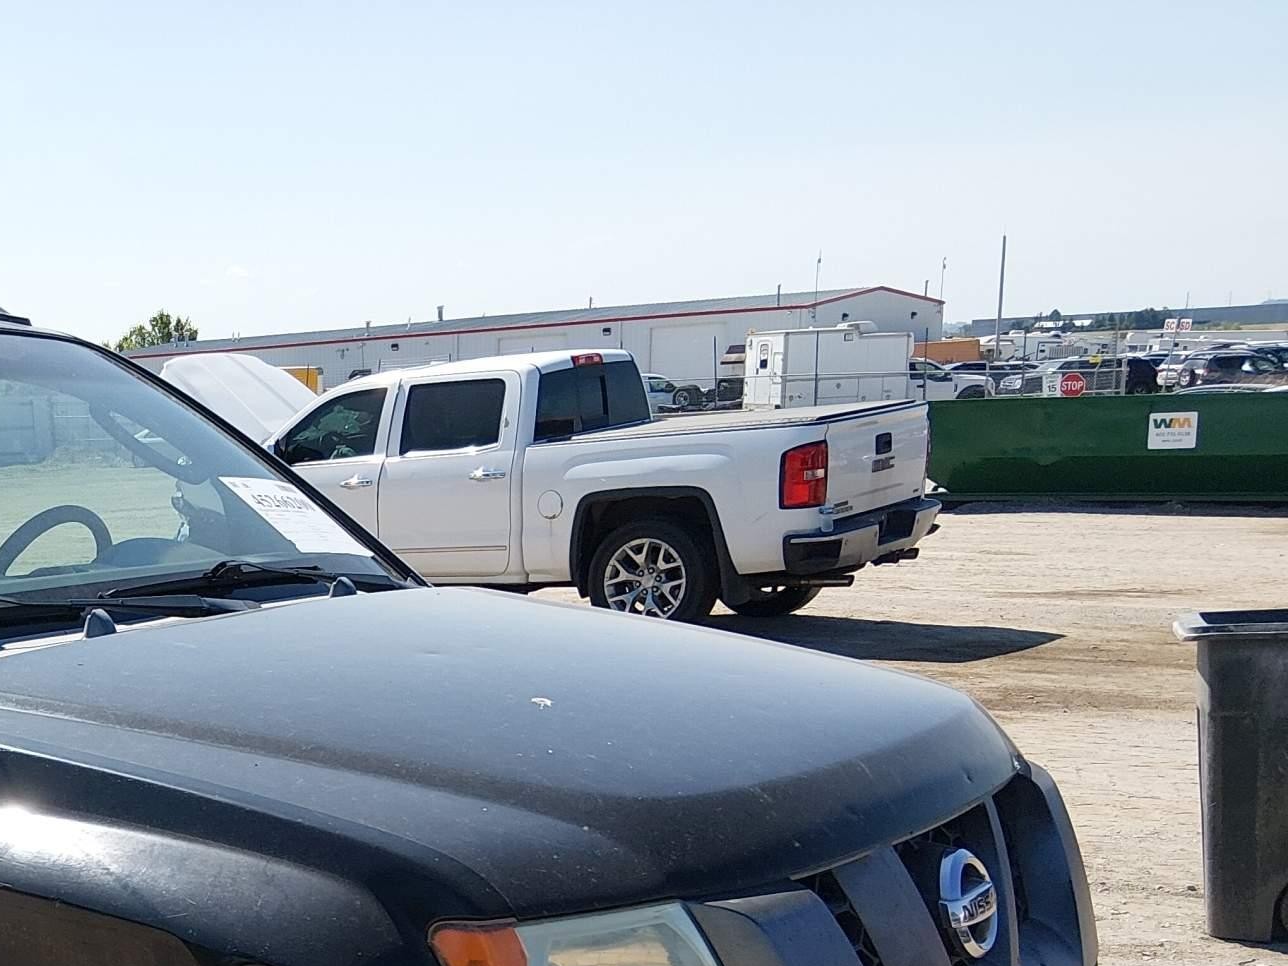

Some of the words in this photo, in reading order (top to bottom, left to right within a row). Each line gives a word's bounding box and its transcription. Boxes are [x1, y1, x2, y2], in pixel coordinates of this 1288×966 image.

[1048, 384, 1057, 393] 15
[1061, 381, 1084, 391] STOP
[1153, 418, 1192, 429] WM
